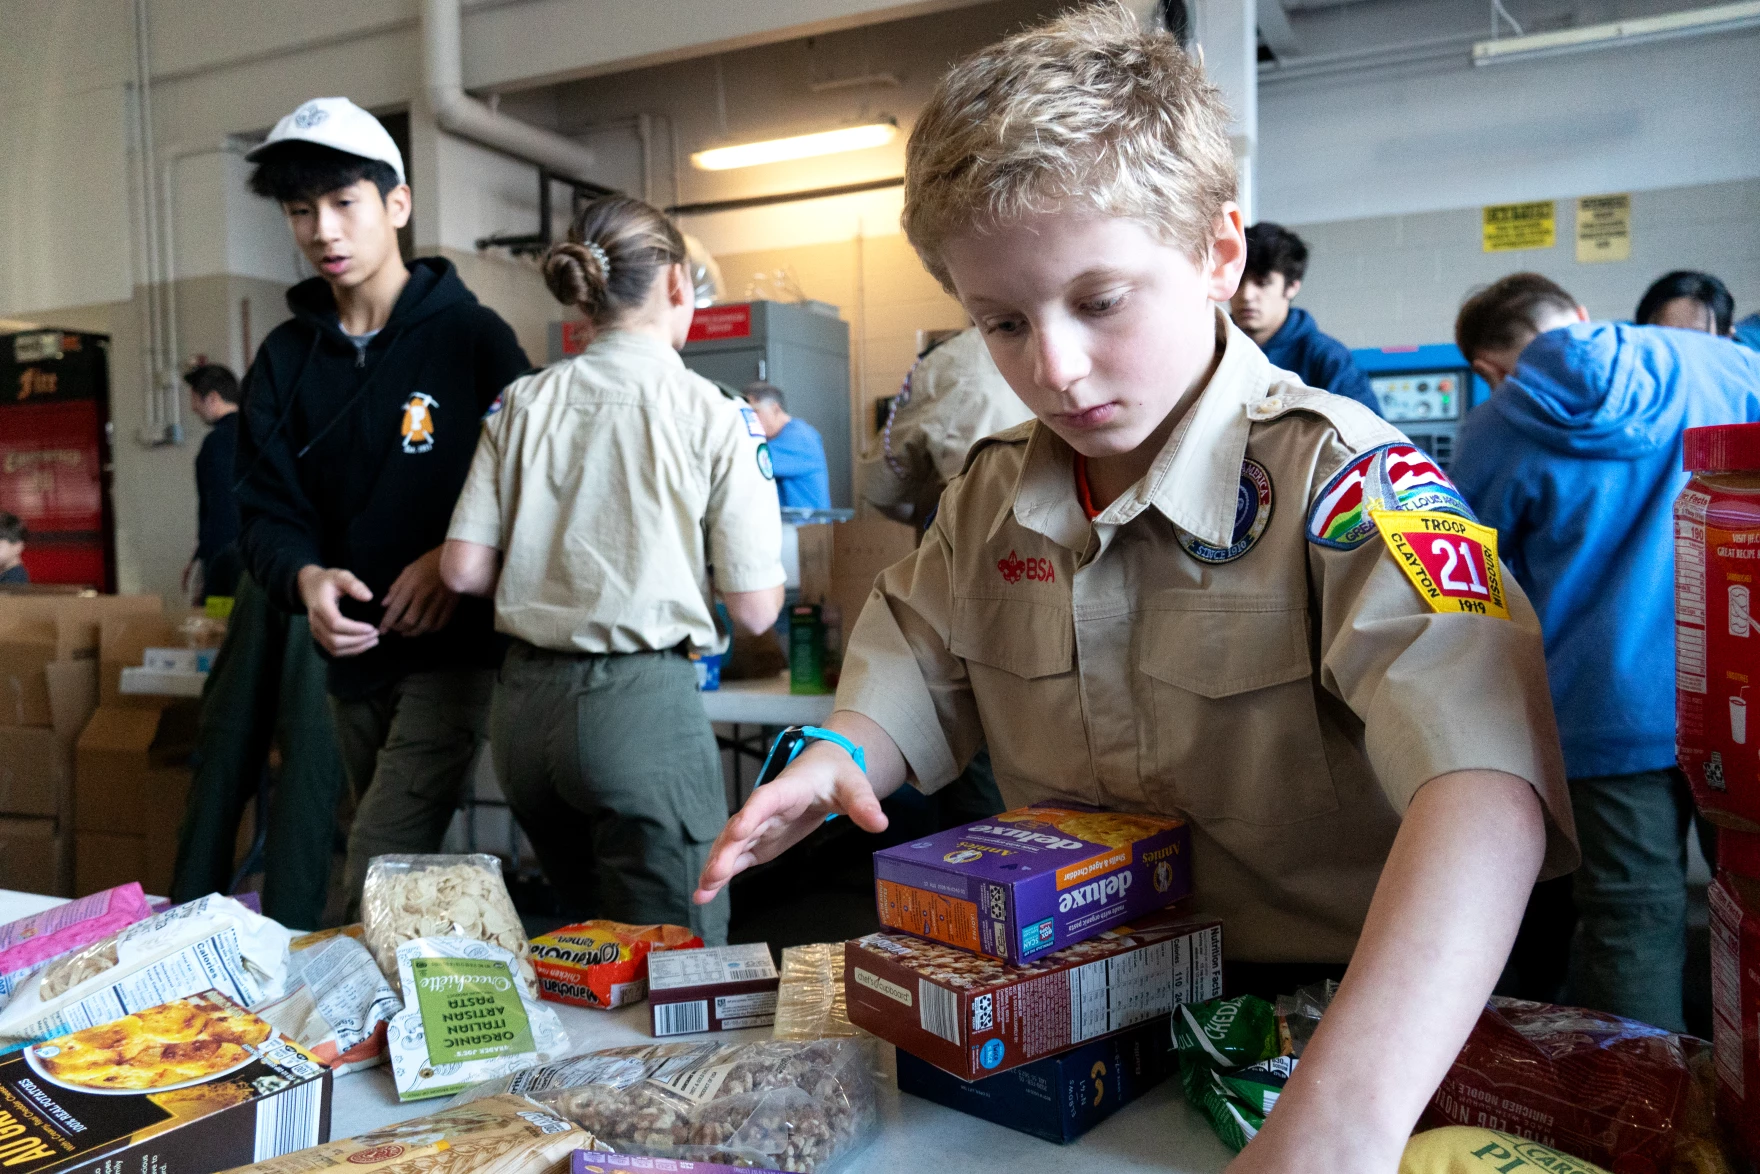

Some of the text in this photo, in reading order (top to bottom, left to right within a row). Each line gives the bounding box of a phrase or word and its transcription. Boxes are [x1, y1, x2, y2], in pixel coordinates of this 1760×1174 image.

[410, 406, 426, 431] P
[1241, 460, 1270, 499] AMERICA
[1413, 494, 1441, 509] LOUIS
[1421, 518, 1466, 534] TROOP
[1691, 526, 1704, 541] 190
[1732, 533, 1747, 544] VISIT
[1196, 540, 1248, 561] SINCE 1910
[1717, 547, 1755, 559] GREAT RECIPE
[1026, 557, 1056, 584] BSA
[1390, 533, 1440, 599] CLAYTON
[1431, 538, 1488, 595] 21
[1483, 545, 1503, 609] MISSOURI
[1458, 599, 1487, 614] 1919
[1726, 671, 1749, 684] SMOOTHIES
[968, 824, 1084, 850] deluxe
[1109, 854, 1125, 864] Shells
[1141, 842, 1178, 866] Annie's
[1064, 868, 1088, 880] Cheddar
[1088, 861, 1102, 872] Aged
[1060, 871, 1129, 912] deluxe
[1068, 905, 1124, 930] made with organic pasta
[558, 935, 596, 947] Ramen
[1024, 938, 1038, 949] SCAN
[196, 942, 219, 979] Calories
[1210, 928, 1220, 996] Nutrition Facts
[419, 974, 512, 993] Orecchiette
[550, 968, 581, 982] Chicken
[544, 980, 599, 1004] Maruchan
[857, 973, 908, 1001] chef's cupboard
[447, 995, 495, 1009] PASTA
[441, 1006, 505, 1022] ARTISAN
[447, 1019, 506, 1035] ITALIAN
[443, 1031, 514, 1048] ORGANIC
[455, 1044, 509, 1058] TRADER JOE'S
[1272, 1063, 1288, 1072] SODIUM
[698, 1083, 710, 1098] PRODUCT
[1069, 1079, 1077, 1117] ELBOWS
[12, 1099, 34, 1118] Cheddar
[18, 1077, 87, 1133] 100% REAL POTATOES
[1458, 1082, 1553, 1126] ENRICHED NOODLE
[30, 1114, 44, 1126] Real
[1524, 1119, 1550, 1133] MADE
[0, 1136, 56, 1167] AU
